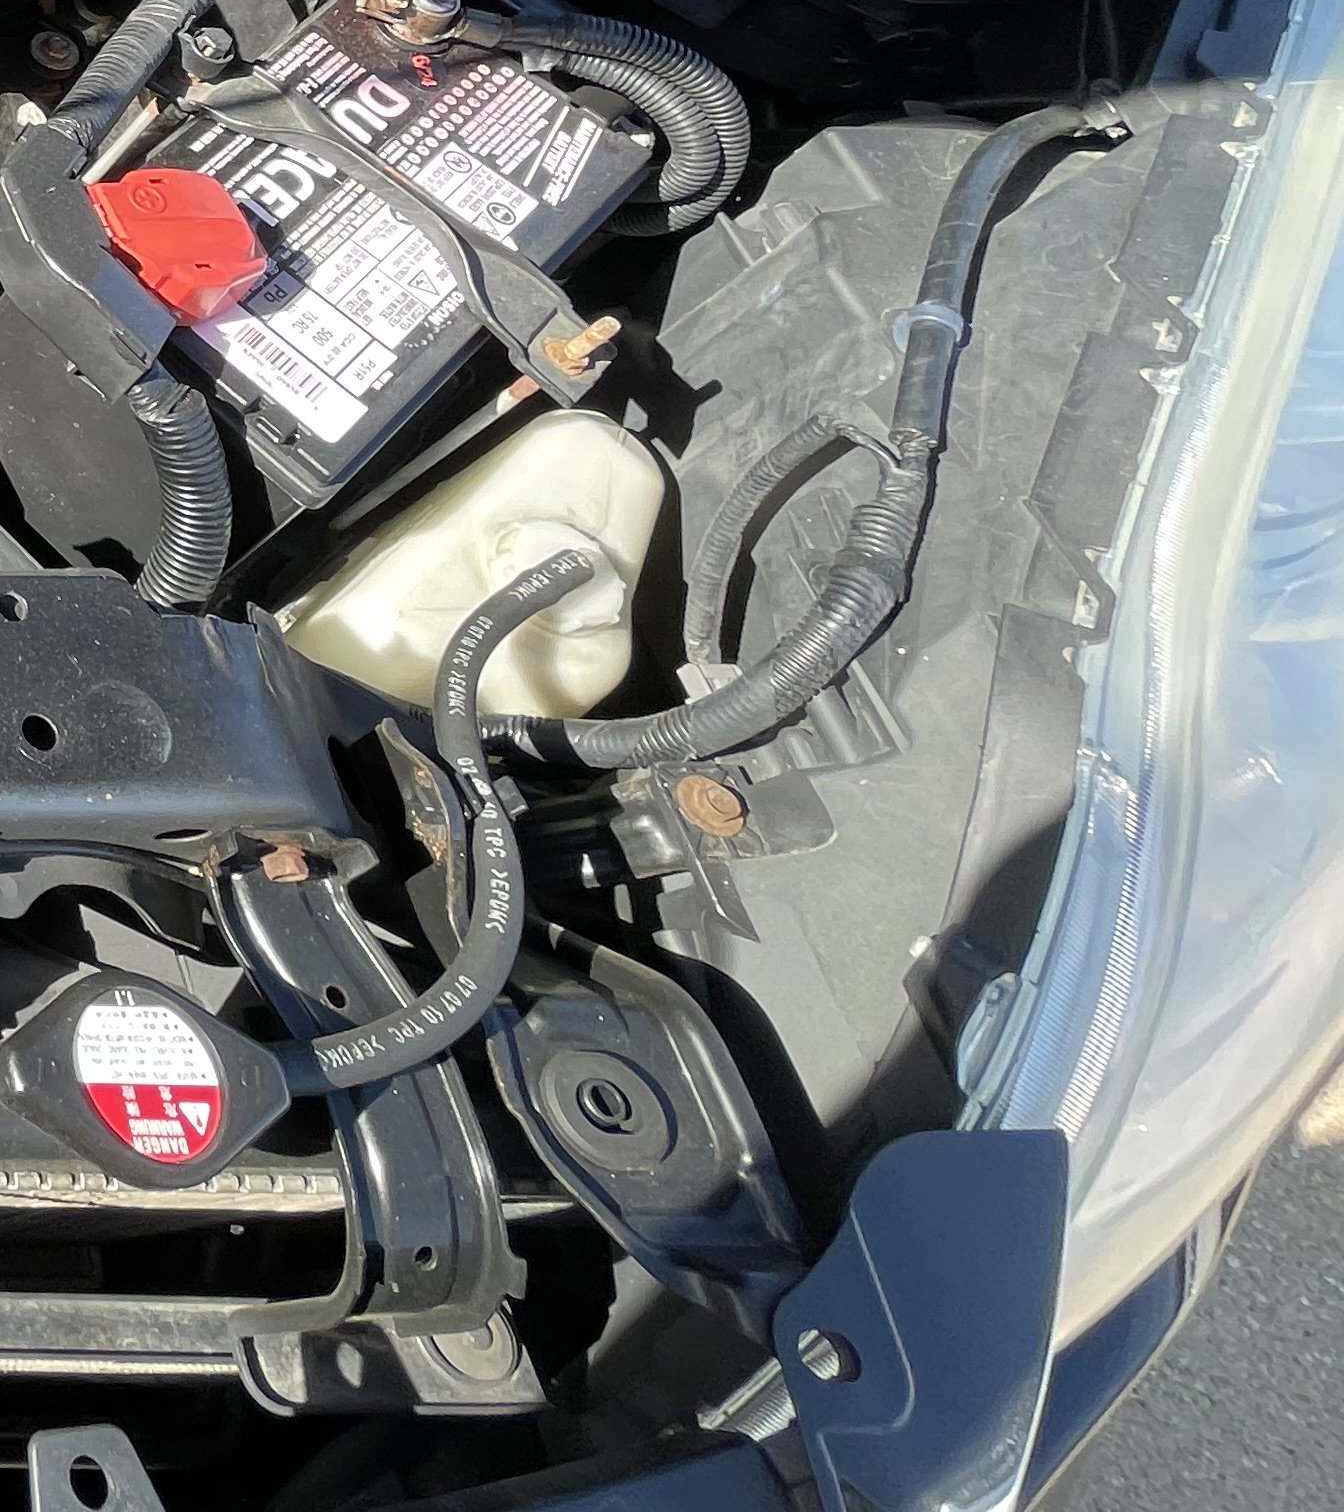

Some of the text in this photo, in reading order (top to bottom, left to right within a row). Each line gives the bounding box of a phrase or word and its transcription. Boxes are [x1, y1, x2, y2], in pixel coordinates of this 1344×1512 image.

[541, 130, 572, 174] BATTERY
[263, 283, 289, 307] Pb
[427, 289, 466, 328] OISON
[291, 309, 319, 335] 75 RC
[311, 326, 334, 348] 500
[453, 648, 473, 667] TPC
[484, 827, 507, 859] TPC
[458, 975, 479, 998] 07
[439, 990, 463, 1014] 07
[420, 1003, 445, 1026] 10
[387, 1019, 426, 1044] TPC
[132, 1136, 190, 1156] DANGER
